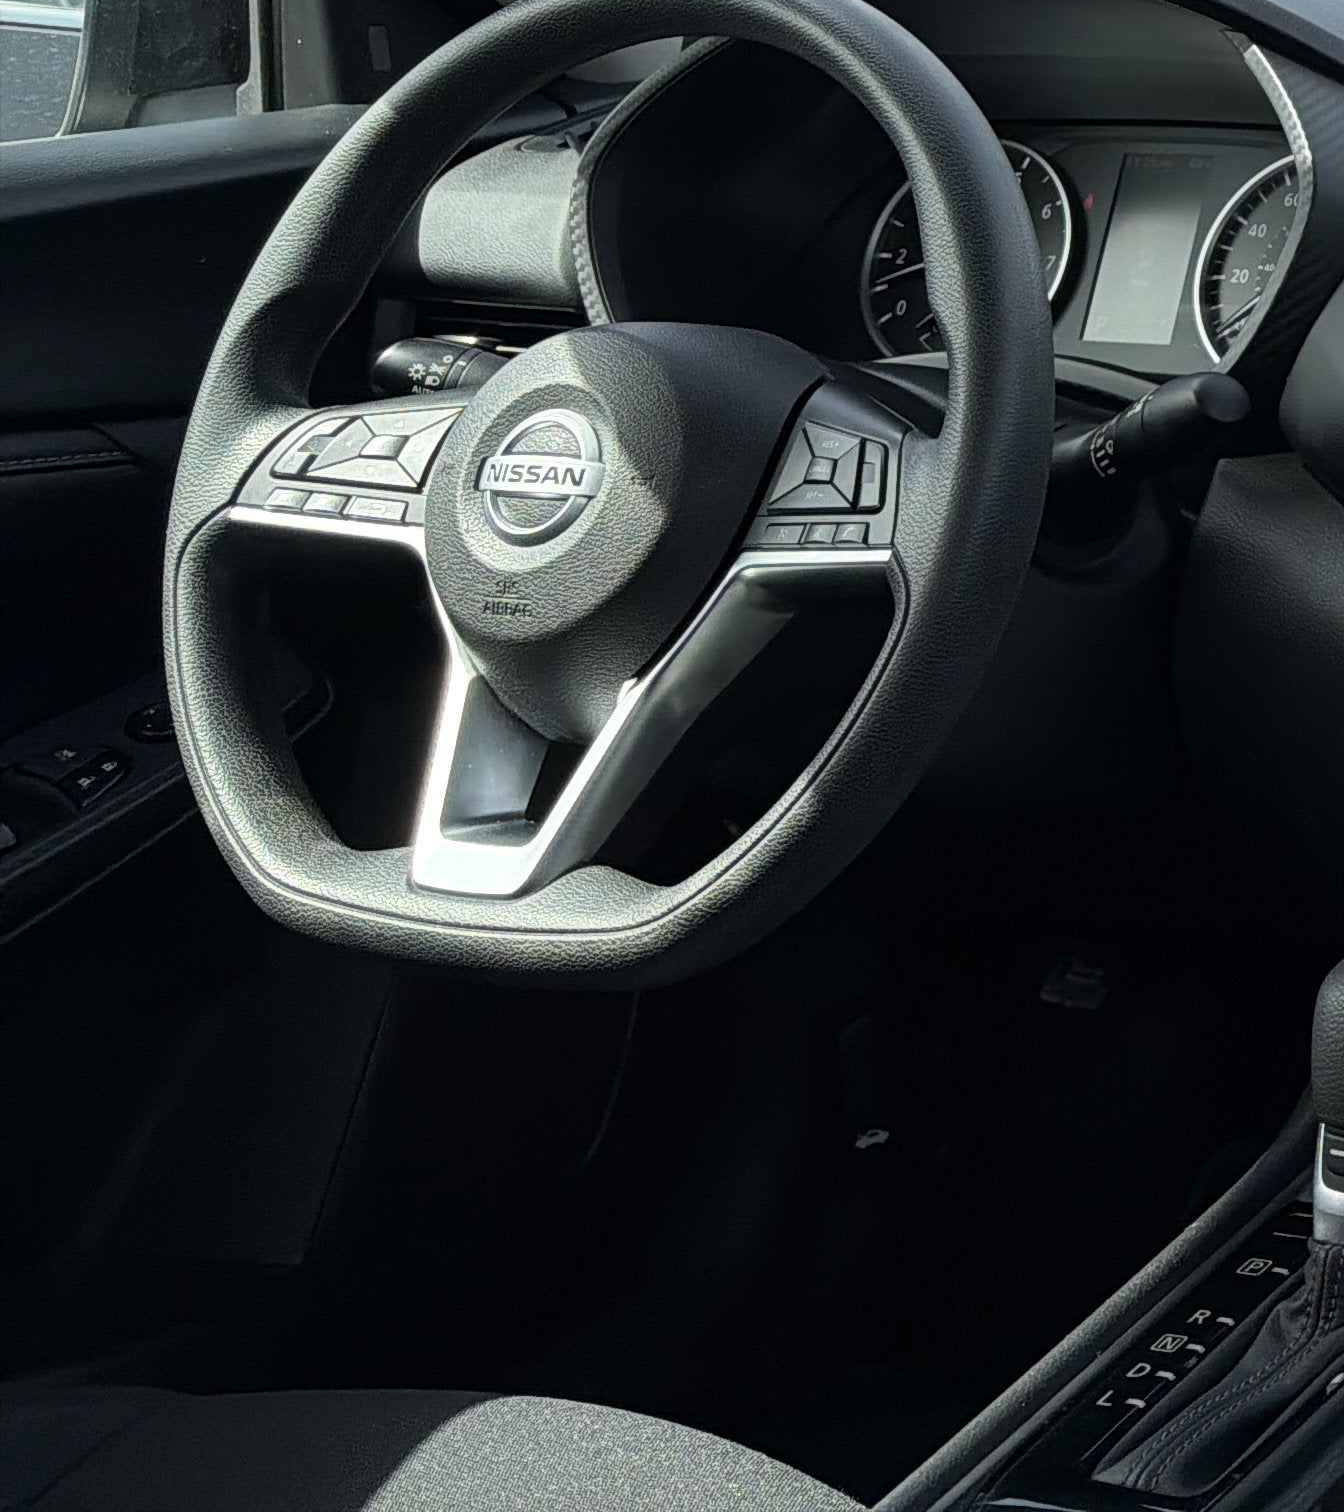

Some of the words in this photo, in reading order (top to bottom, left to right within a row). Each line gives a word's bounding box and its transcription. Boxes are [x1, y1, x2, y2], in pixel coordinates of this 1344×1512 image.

[1041, 204, 1052, 220] 6
[1247, 223, 1267, 238] 40
[895, 248, 908, 264] 2
[1045, 255, 1057, 271] 7
[1229, 268, 1250, 284] 20
[896, 300, 907, 316] 0
[486, 462, 586, 487] NISSAN
[495, 580, 519, 594] SRS
[482, 600, 533, 617] AIRBAG
[1245, 1260, 1264, 1273] P
[1188, 1309, 1210, 1325] R
[1160, 1336, 1179, 1350] N
[1126, 1363, 1150, 1378] D
[1095, 1389, 1115, 1406] L
